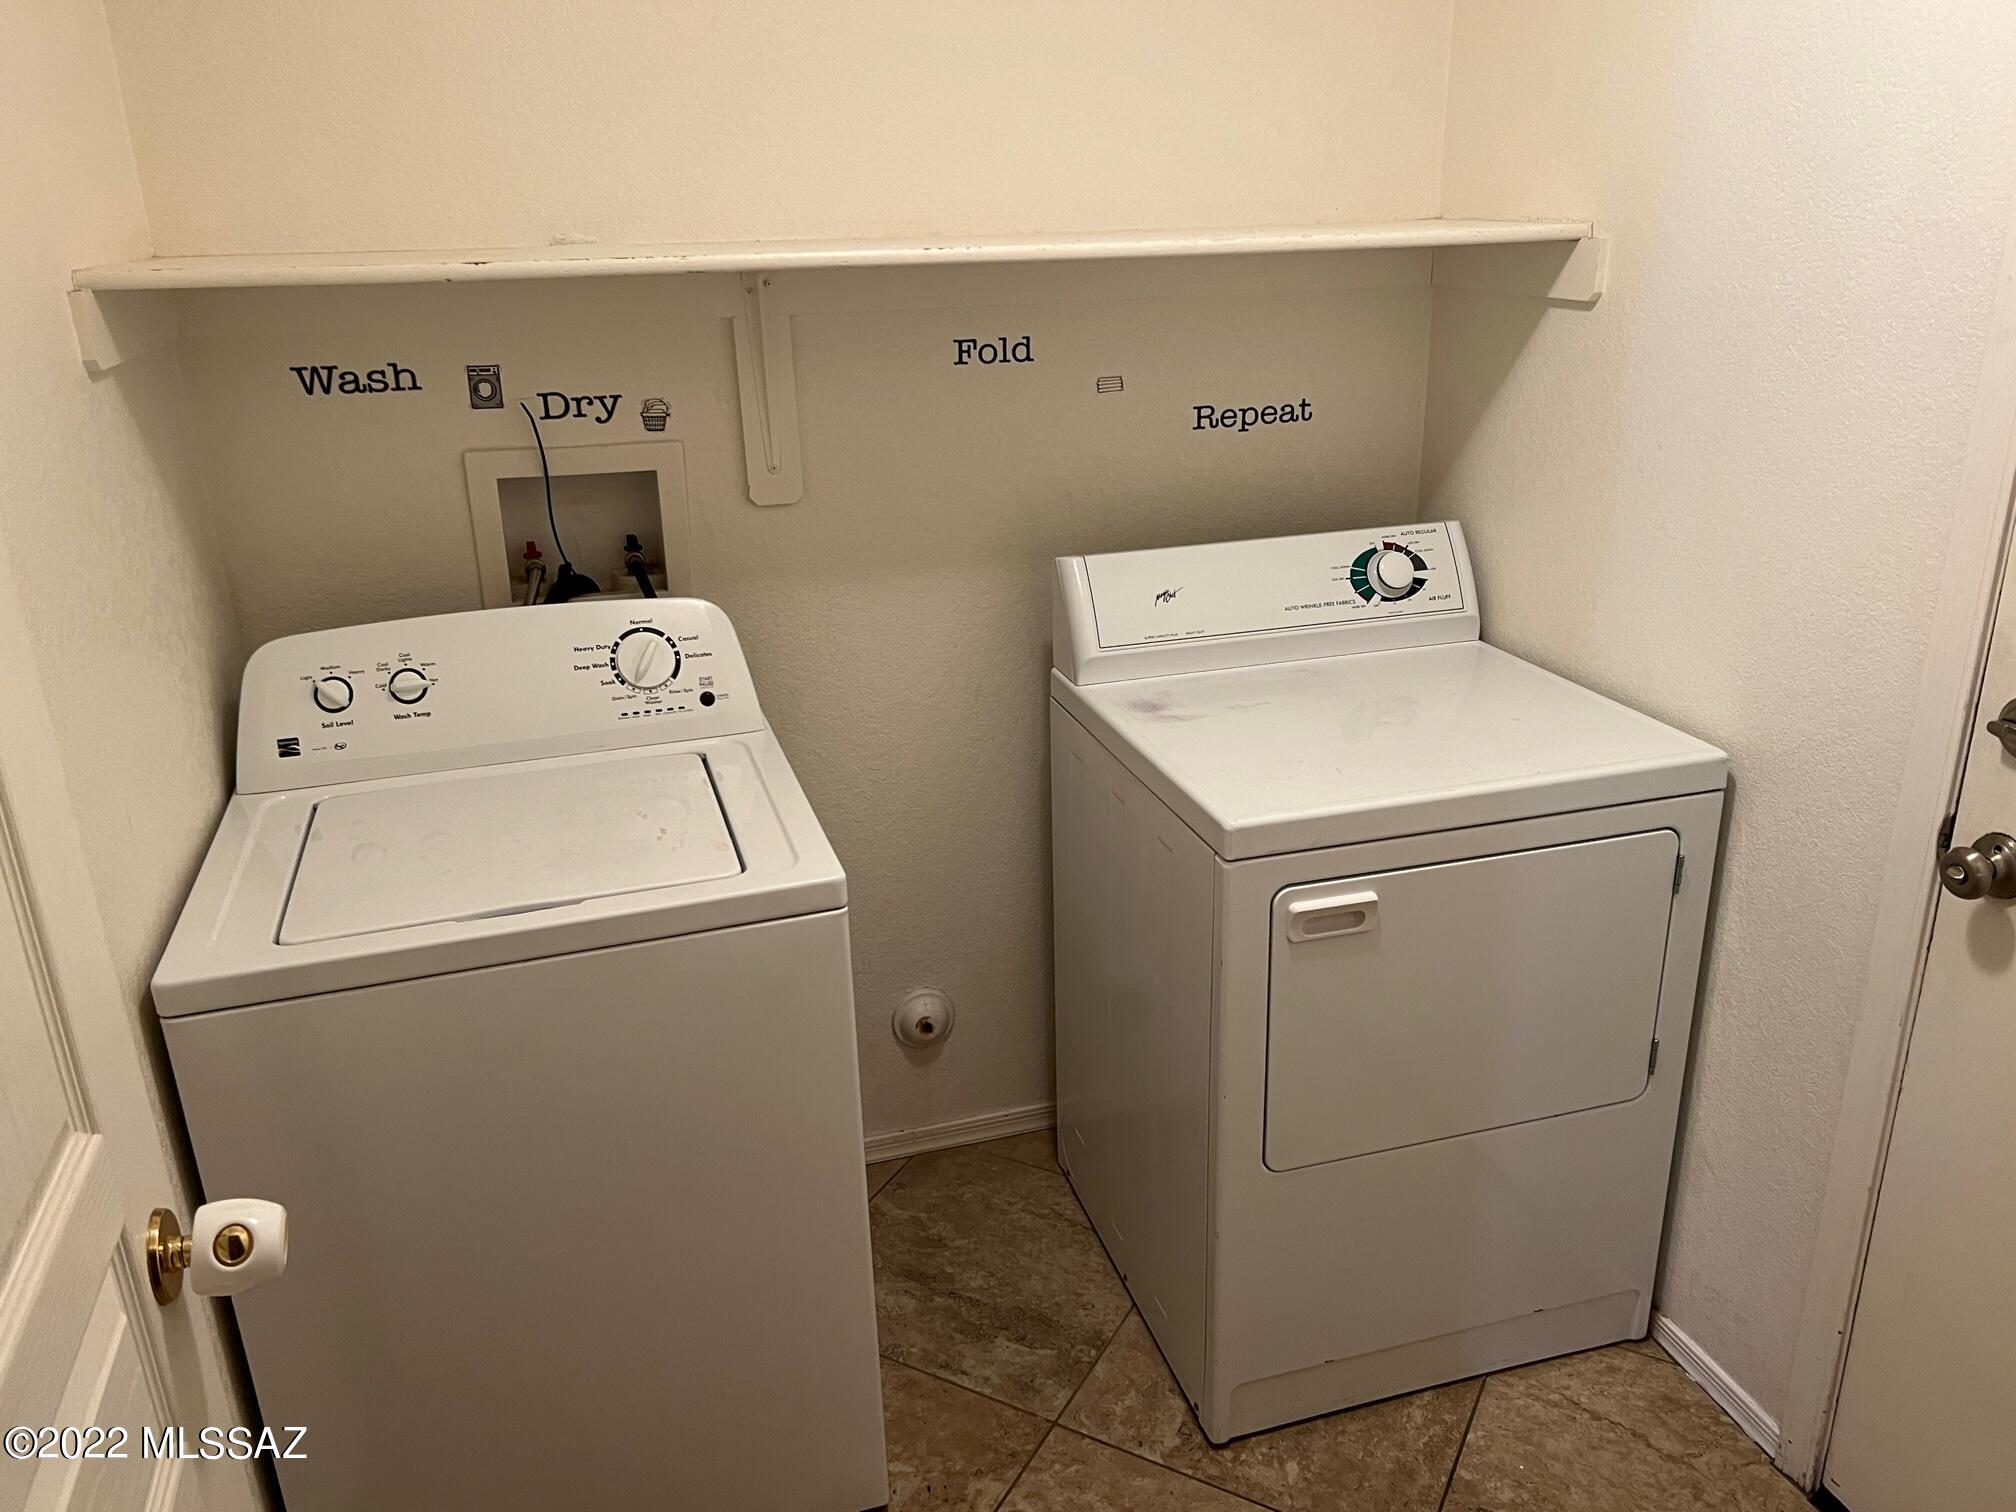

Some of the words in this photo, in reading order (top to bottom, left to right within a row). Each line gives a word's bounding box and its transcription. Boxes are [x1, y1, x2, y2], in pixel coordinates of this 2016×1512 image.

[953, 336, 1034, 365] Fold
[289, 362, 423, 396] Wash
[536, 391, 622, 424] Dry
[1192, 398, 1313, 432] Repeat
[678, 634, 699, 642] Casual
[573, 645, 594, 653] Heavy
[685, 651, 713, 659] Delicates
[321, 721, 334, 729] Soil
